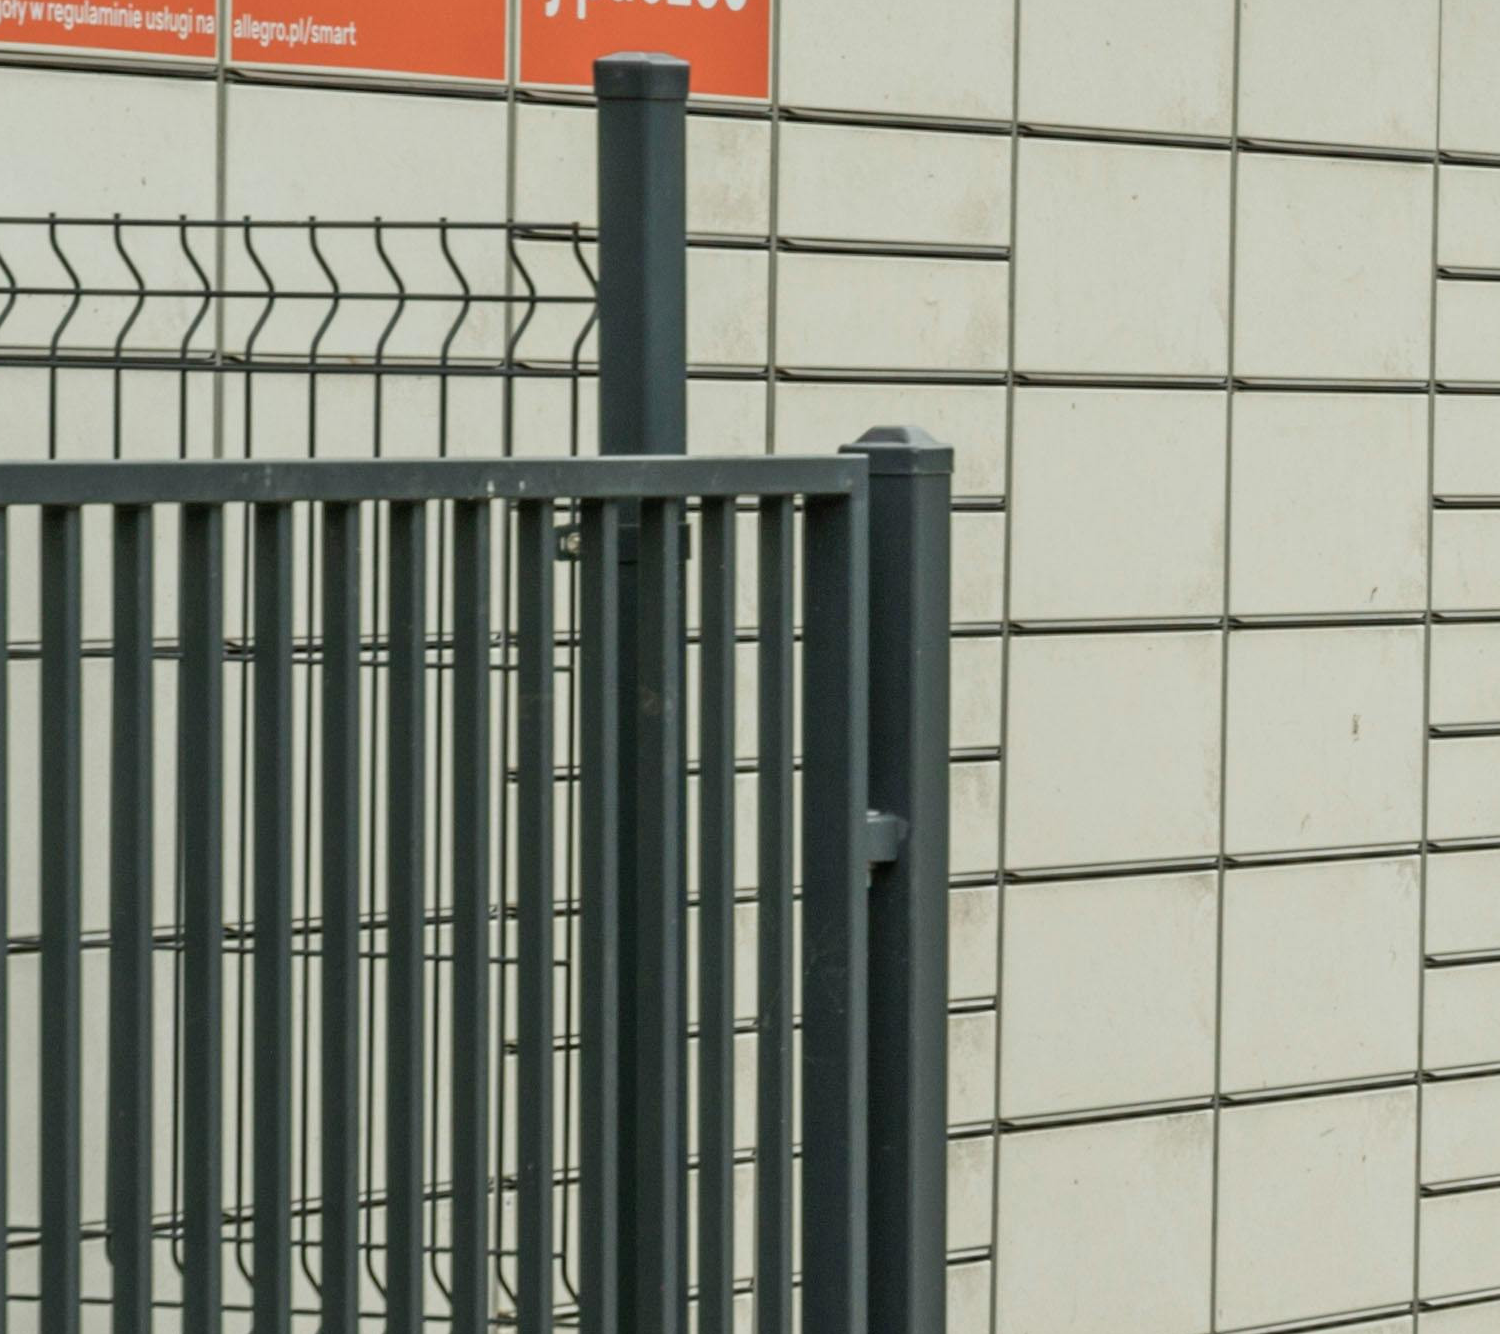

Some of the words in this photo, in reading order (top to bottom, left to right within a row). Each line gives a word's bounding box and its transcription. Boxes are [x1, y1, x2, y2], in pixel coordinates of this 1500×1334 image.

[29, 1, 43, 20] w
[145, 8, 194, 40] usługi
[196, 14, 216, 35] na
[232, 15, 357, 48] allegro.pl/smart
